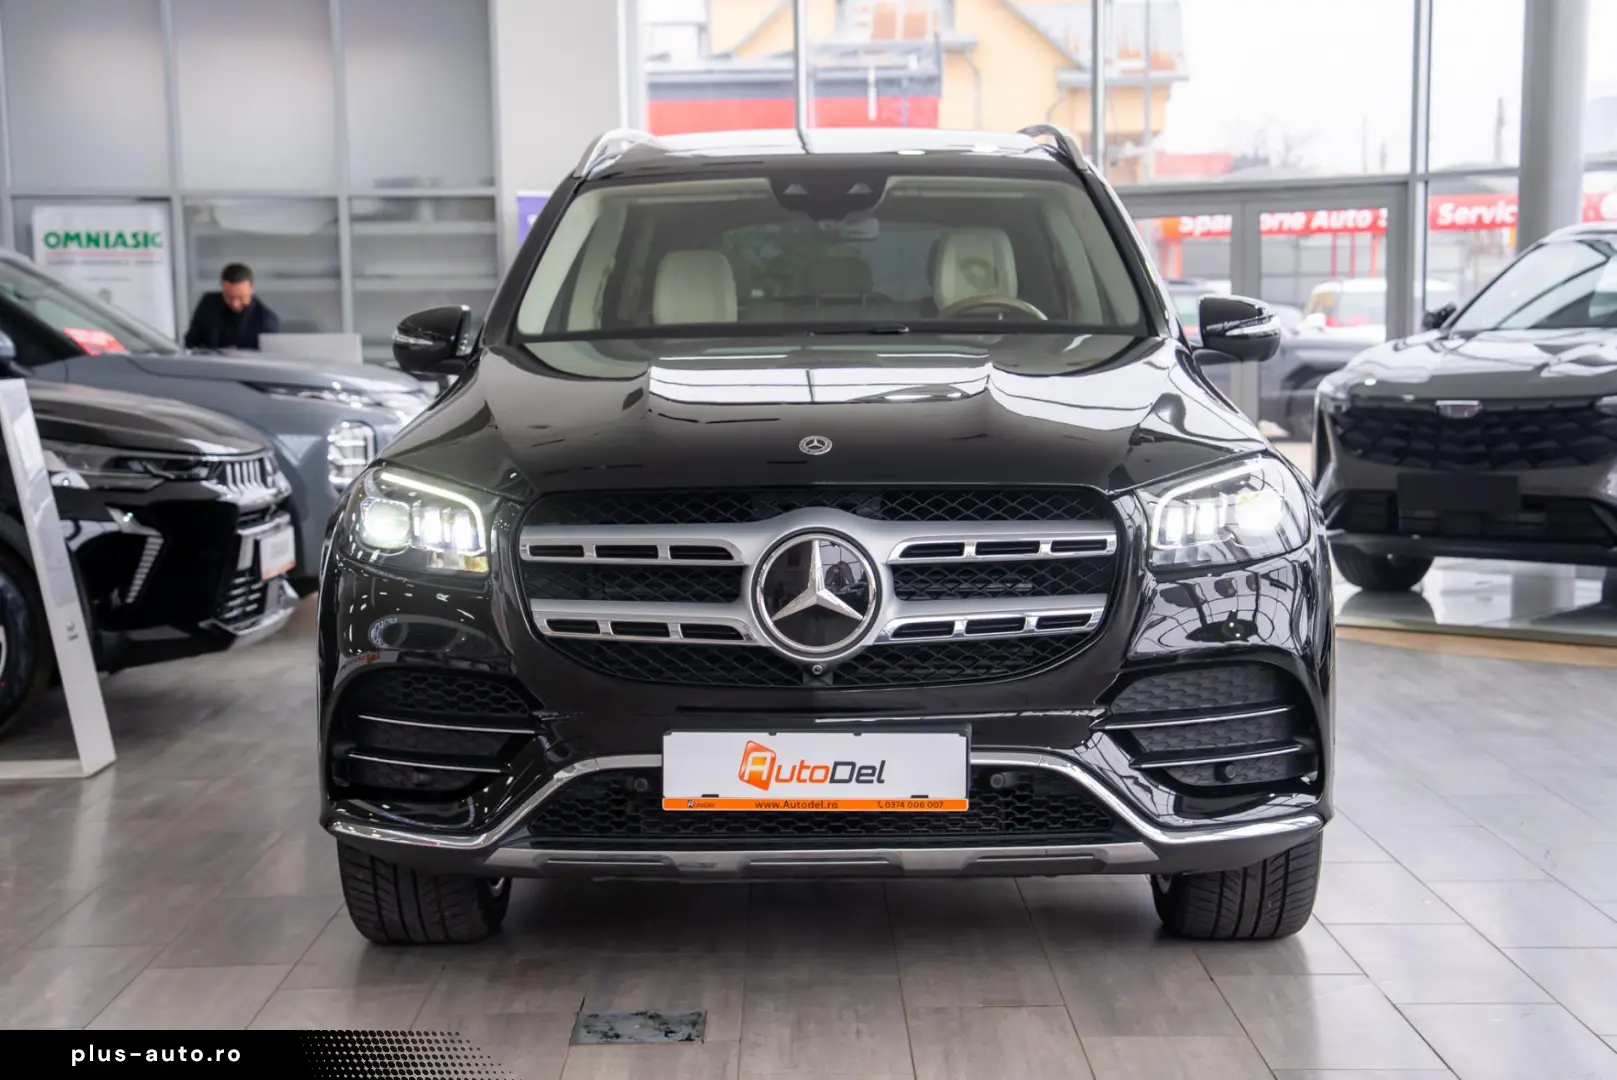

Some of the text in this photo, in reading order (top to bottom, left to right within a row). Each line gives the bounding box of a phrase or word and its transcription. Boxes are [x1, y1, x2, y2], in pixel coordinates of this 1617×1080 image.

[1311, 208, 1372, 231] Auto
[1436, 201, 1518, 225] Servic
[738, 740, 886, 791] AutoDel
[755, 800, 838, 809] www.Autodel.ro
[885, 801, 944, 809] 0374 006 007
